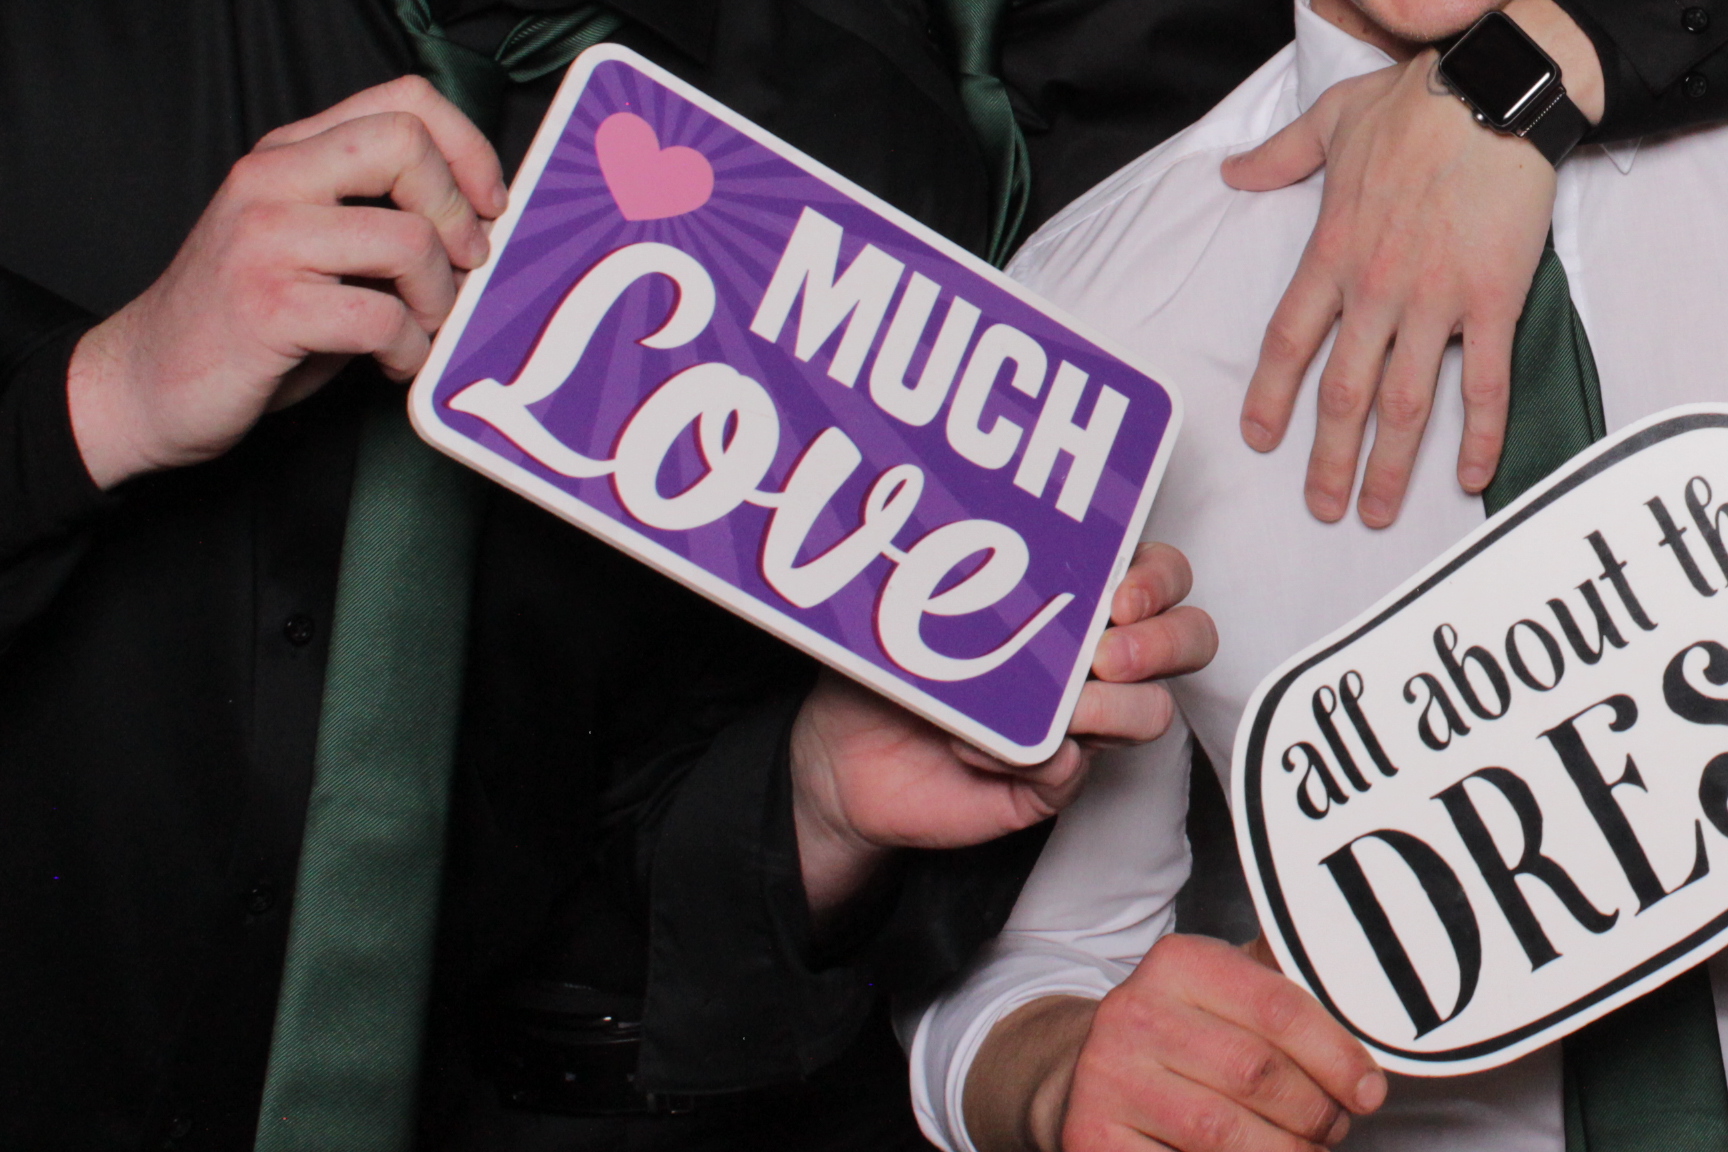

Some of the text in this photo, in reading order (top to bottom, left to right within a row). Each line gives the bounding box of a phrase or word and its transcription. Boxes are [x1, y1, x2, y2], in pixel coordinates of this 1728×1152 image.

[447, 241, 1075, 682] Love
[749, 206, 1130, 523] MUCH
[1280, 669, 1399, 820] all
[1402, 529, 1658, 751] about
